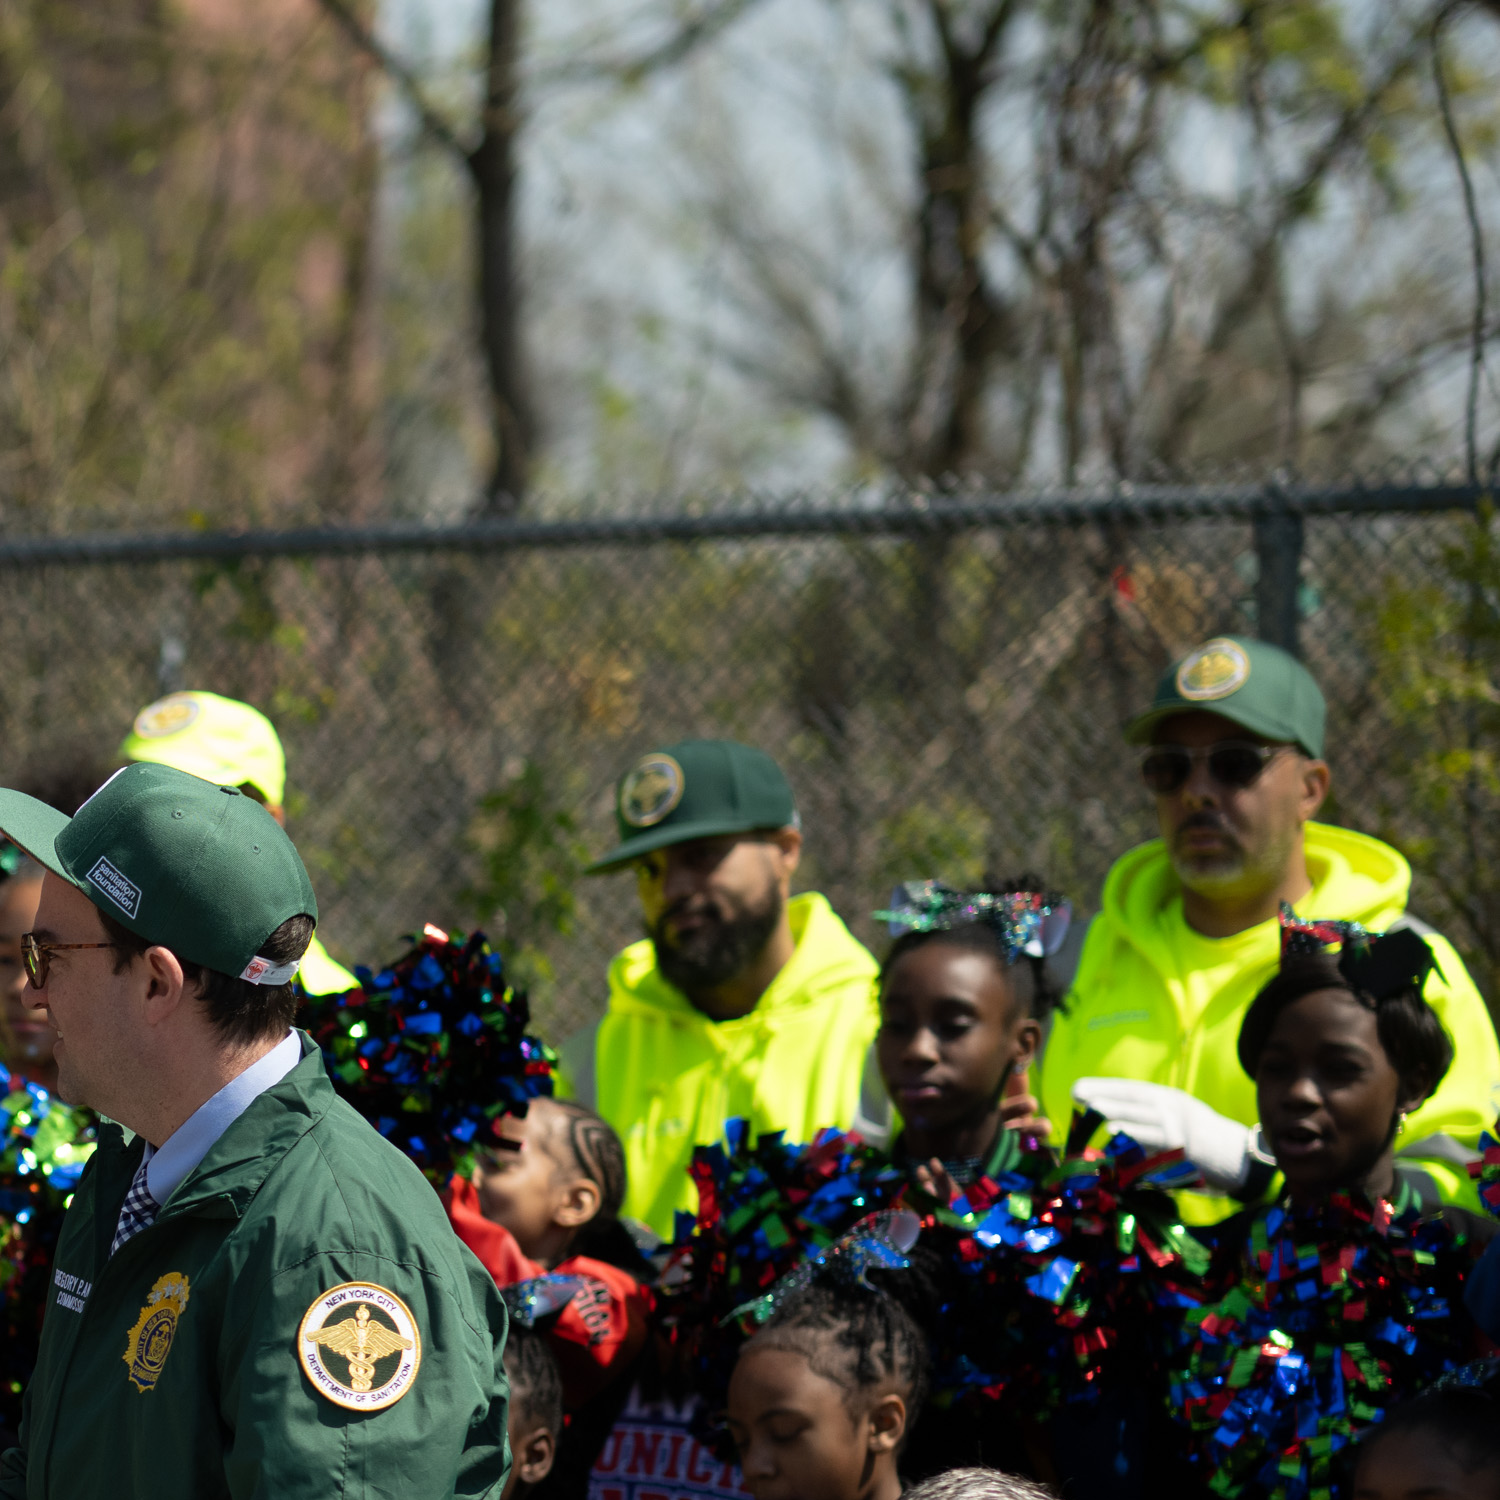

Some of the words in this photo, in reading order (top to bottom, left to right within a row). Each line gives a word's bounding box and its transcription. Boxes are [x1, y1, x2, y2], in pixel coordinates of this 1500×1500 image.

[92, 869, 134, 910] foundation
[99, 863, 136, 899] sanitation
[324, 1292, 347, 1309] NEW
[348, 1289, 376, 1300] YORK
[376, 1295, 398, 1312] CITY
[307, 1353, 354, 1401] DEPARTMENT
[355, 1394, 367, 1402] OF
[370, 1362, 412, 1402] SANITATION
